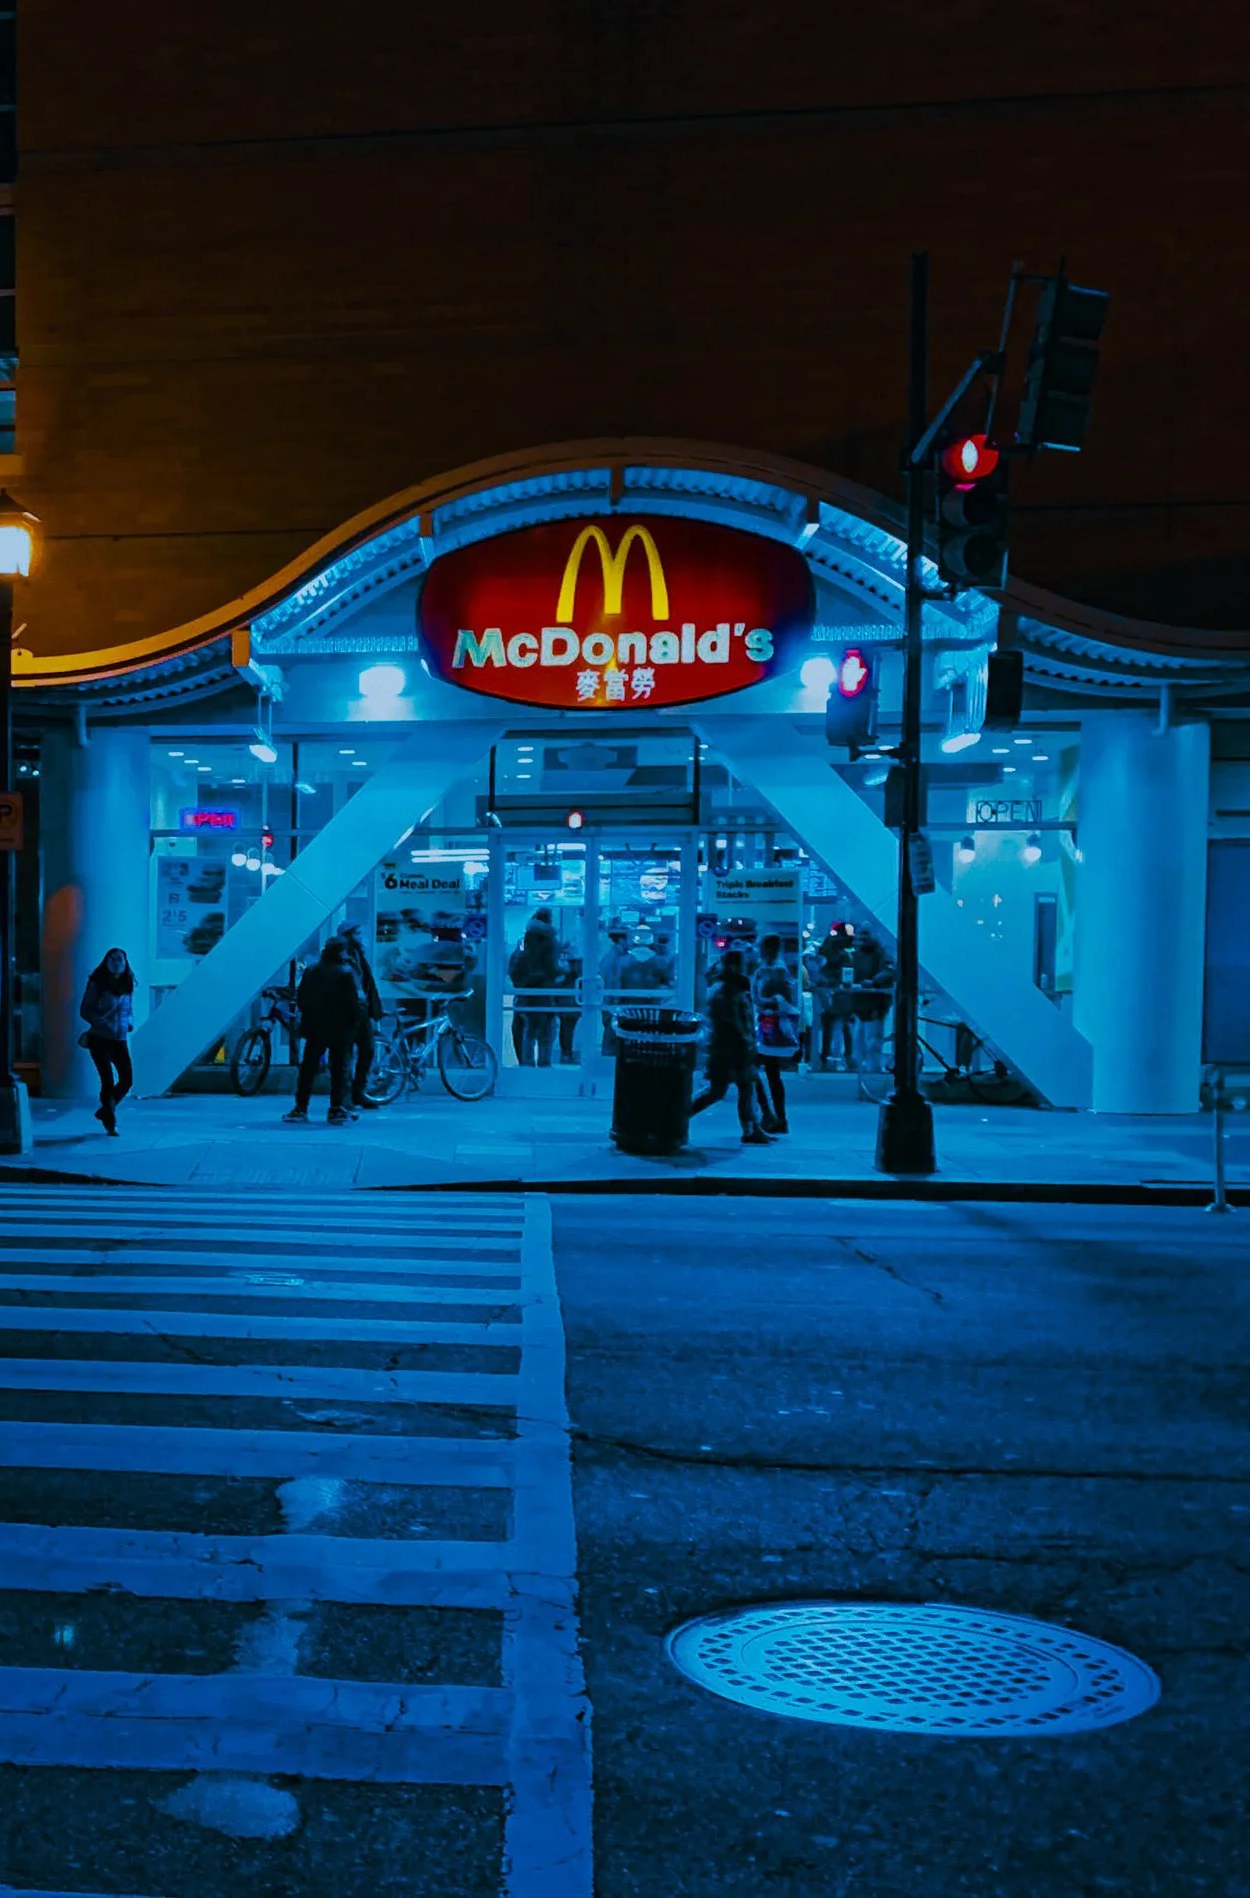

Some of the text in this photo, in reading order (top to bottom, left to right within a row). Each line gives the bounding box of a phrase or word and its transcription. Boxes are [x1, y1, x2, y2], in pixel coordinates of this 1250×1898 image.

[452, 622, 775, 669] McDonald's
[576, 667, 655, 702] 麥當勞
[976, 800, 1042, 824] OPEN
